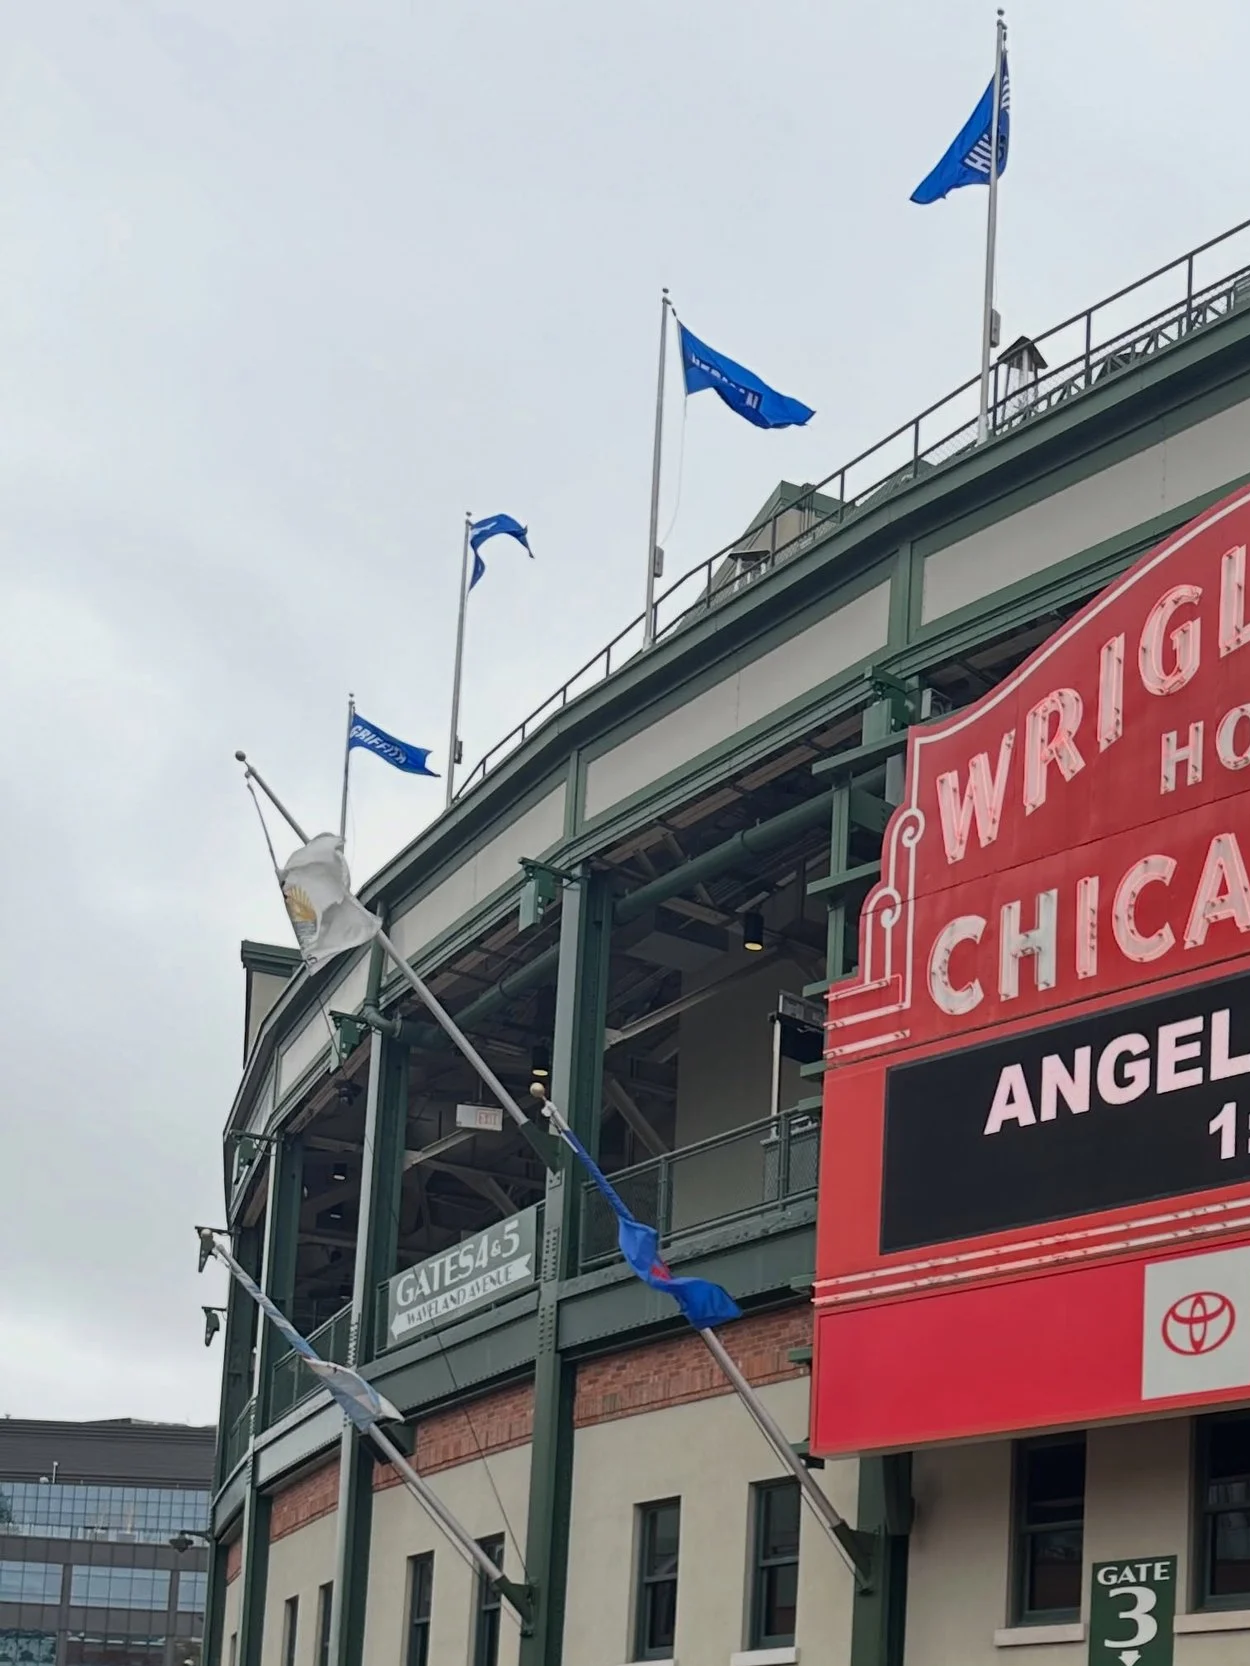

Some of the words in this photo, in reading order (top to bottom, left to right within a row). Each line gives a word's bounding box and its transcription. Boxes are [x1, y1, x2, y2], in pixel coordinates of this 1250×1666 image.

[396, 1244, 474, 1307] GATES
[474, 1234, 489, 1269] 4
[490, 1239, 501, 1257] &
[500, 1219, 520, 1259] 5
[407, 1284, 467, 1326] WAVELAND
[466, 1264, 513, 1300] AVENUE
[1097, 1561, 1170, 1586] GATE
[1104, 1586, 1158, 1649] 3
